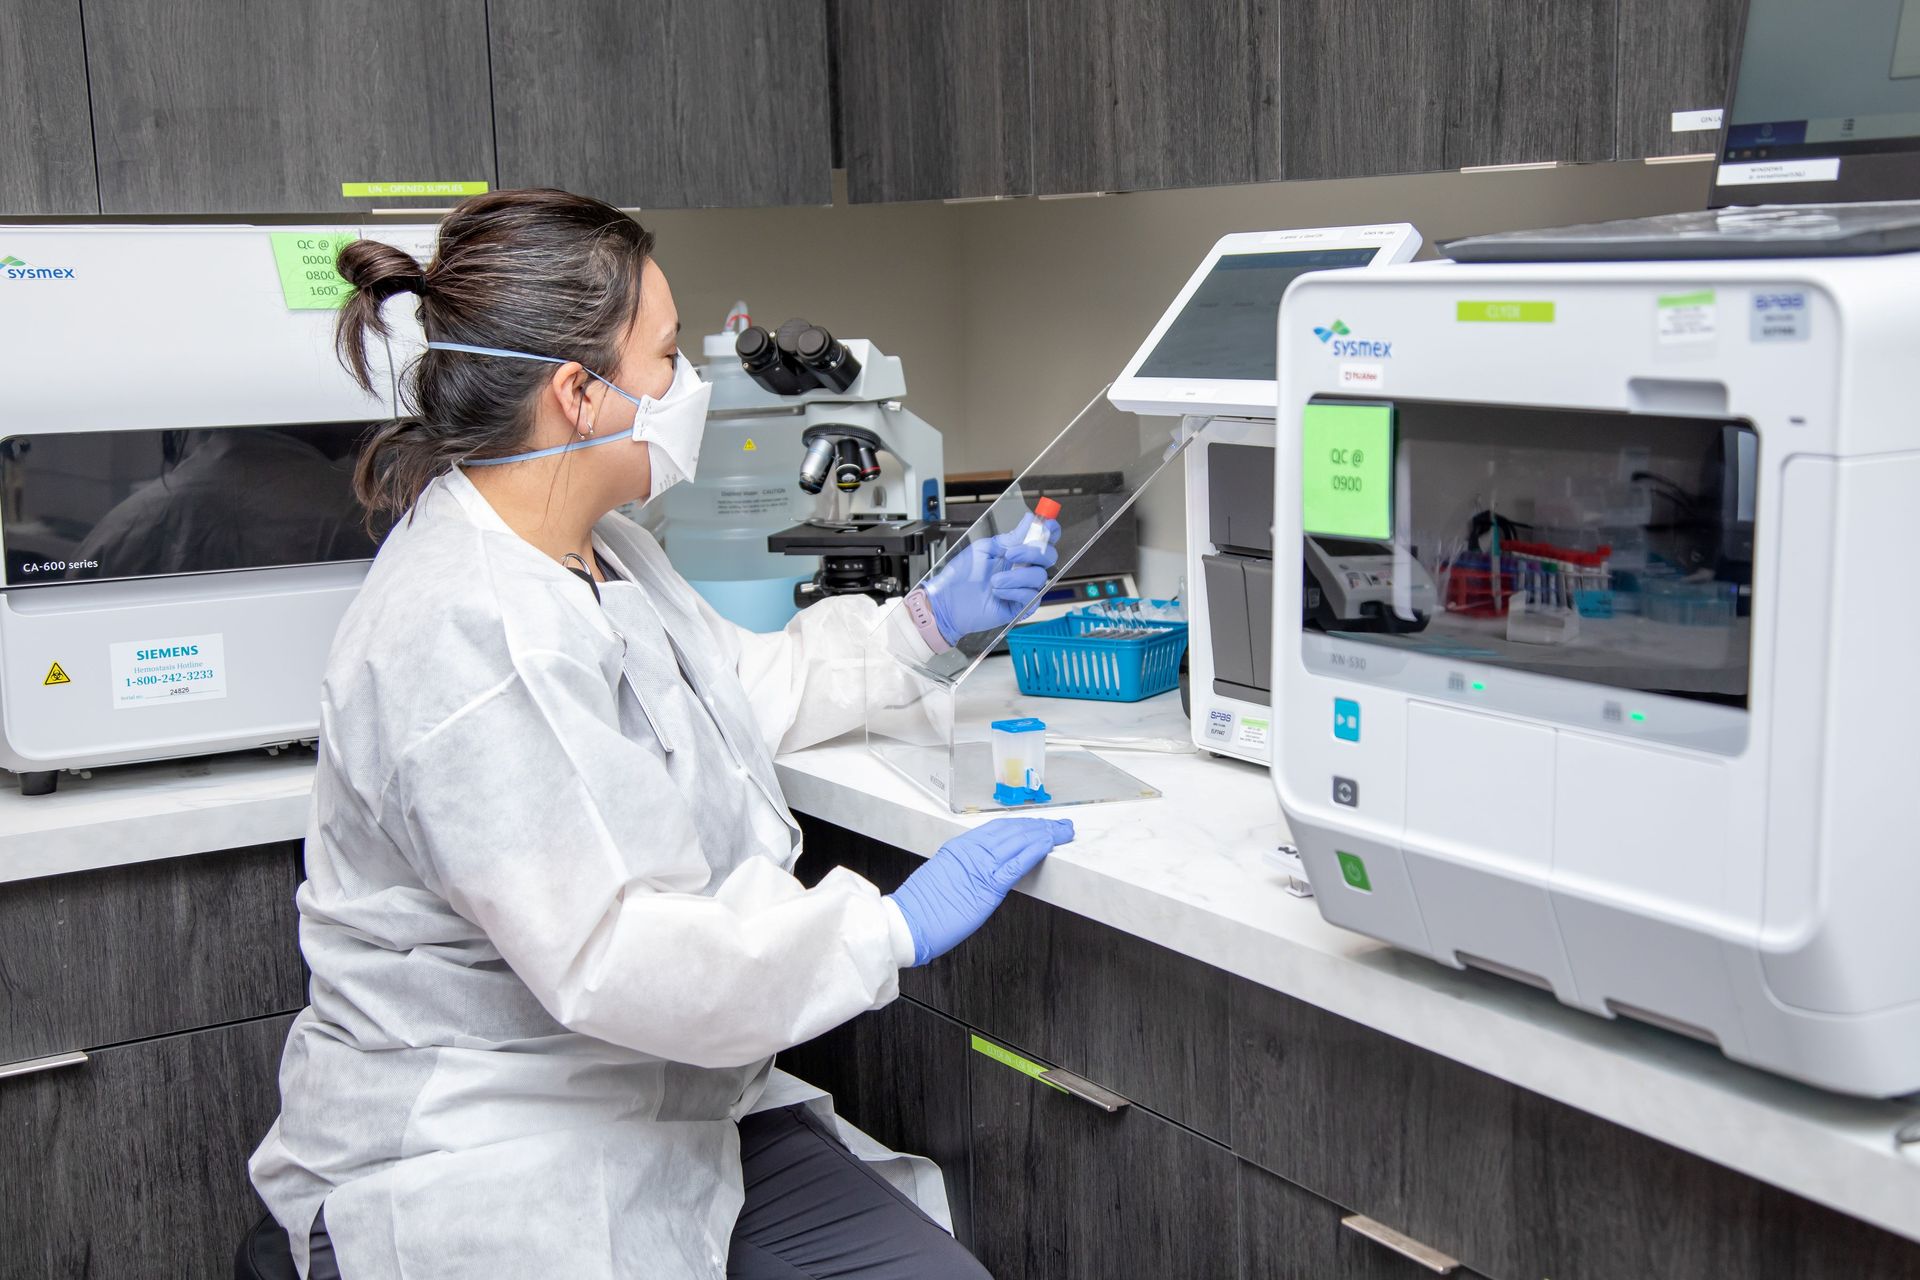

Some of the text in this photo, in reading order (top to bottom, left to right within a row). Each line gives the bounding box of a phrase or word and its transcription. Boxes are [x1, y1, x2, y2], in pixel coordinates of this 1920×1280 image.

[389, 184, 425, 193] OPENED
[426, 183, 463, 193] SUPPLIES
[297, 239, 330, 251] QC @
[302, 255, 332, 265] 0000
[7, 268, 76, 279] sysmex
[305, 270, 335, 281] 0800
[310, 286, 339, 296] 1600
[1333, 339, 1393, 358] sysmex
[1331, 448, 1364, 468] QC @
[1333, 475, 1362, 492] 0900
[22, 559, 99, 573] CA-600 series
[136, 645, 199, 661] SIEMENS
[134, 661, 203, 674] Hemostasis Hotline
[126, 669, 214, 687] 1-800-242-3233
